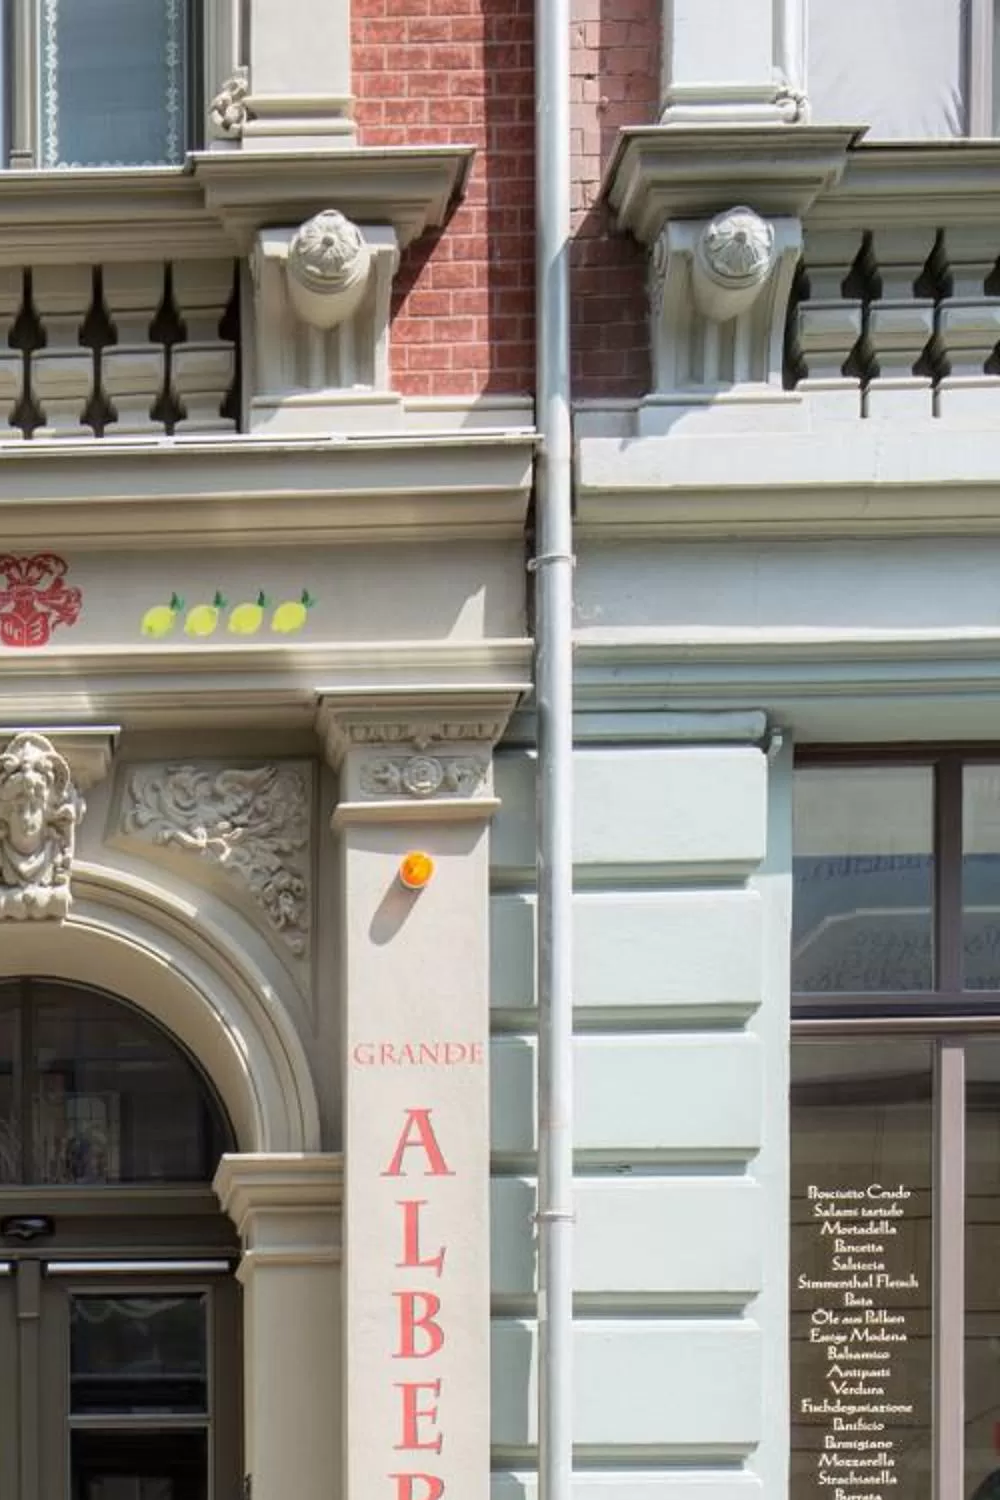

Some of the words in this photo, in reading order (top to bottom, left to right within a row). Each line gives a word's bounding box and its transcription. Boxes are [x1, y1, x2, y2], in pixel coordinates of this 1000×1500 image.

[353, 1041, 484, 1067] GRANDE
[866, 1183, 911, 1199] Crudo
[814, 1202, 858, 1217] Salami
[861, 1202, 904, 1217] tartufo
[820, 1220, 897, 1235] Mortadella
[834, 1238, 884, 1253] Pancetta
[798, 1273, 873, 1289] Simmenthal
[875, 1273, 919, 1288] Fleisch
[844, 1291, 873, 1306] Pasta
[811, 1307, 840, 1325] Öle
[841, 1315, 862, 1324] aus
[849, 1327, 907, 1342] Modena
[827, 1345, 891, 1360] Balsamico
[826, 1363, 891, 1379] Antipasti
[829, 1380, 884, 1395] Verdura
[833, 1417, 885, 1431] Panificio
[824, 1435, 893, 1451] Parmigiano
[817, 1452, 895, 1467] Mozzarella
